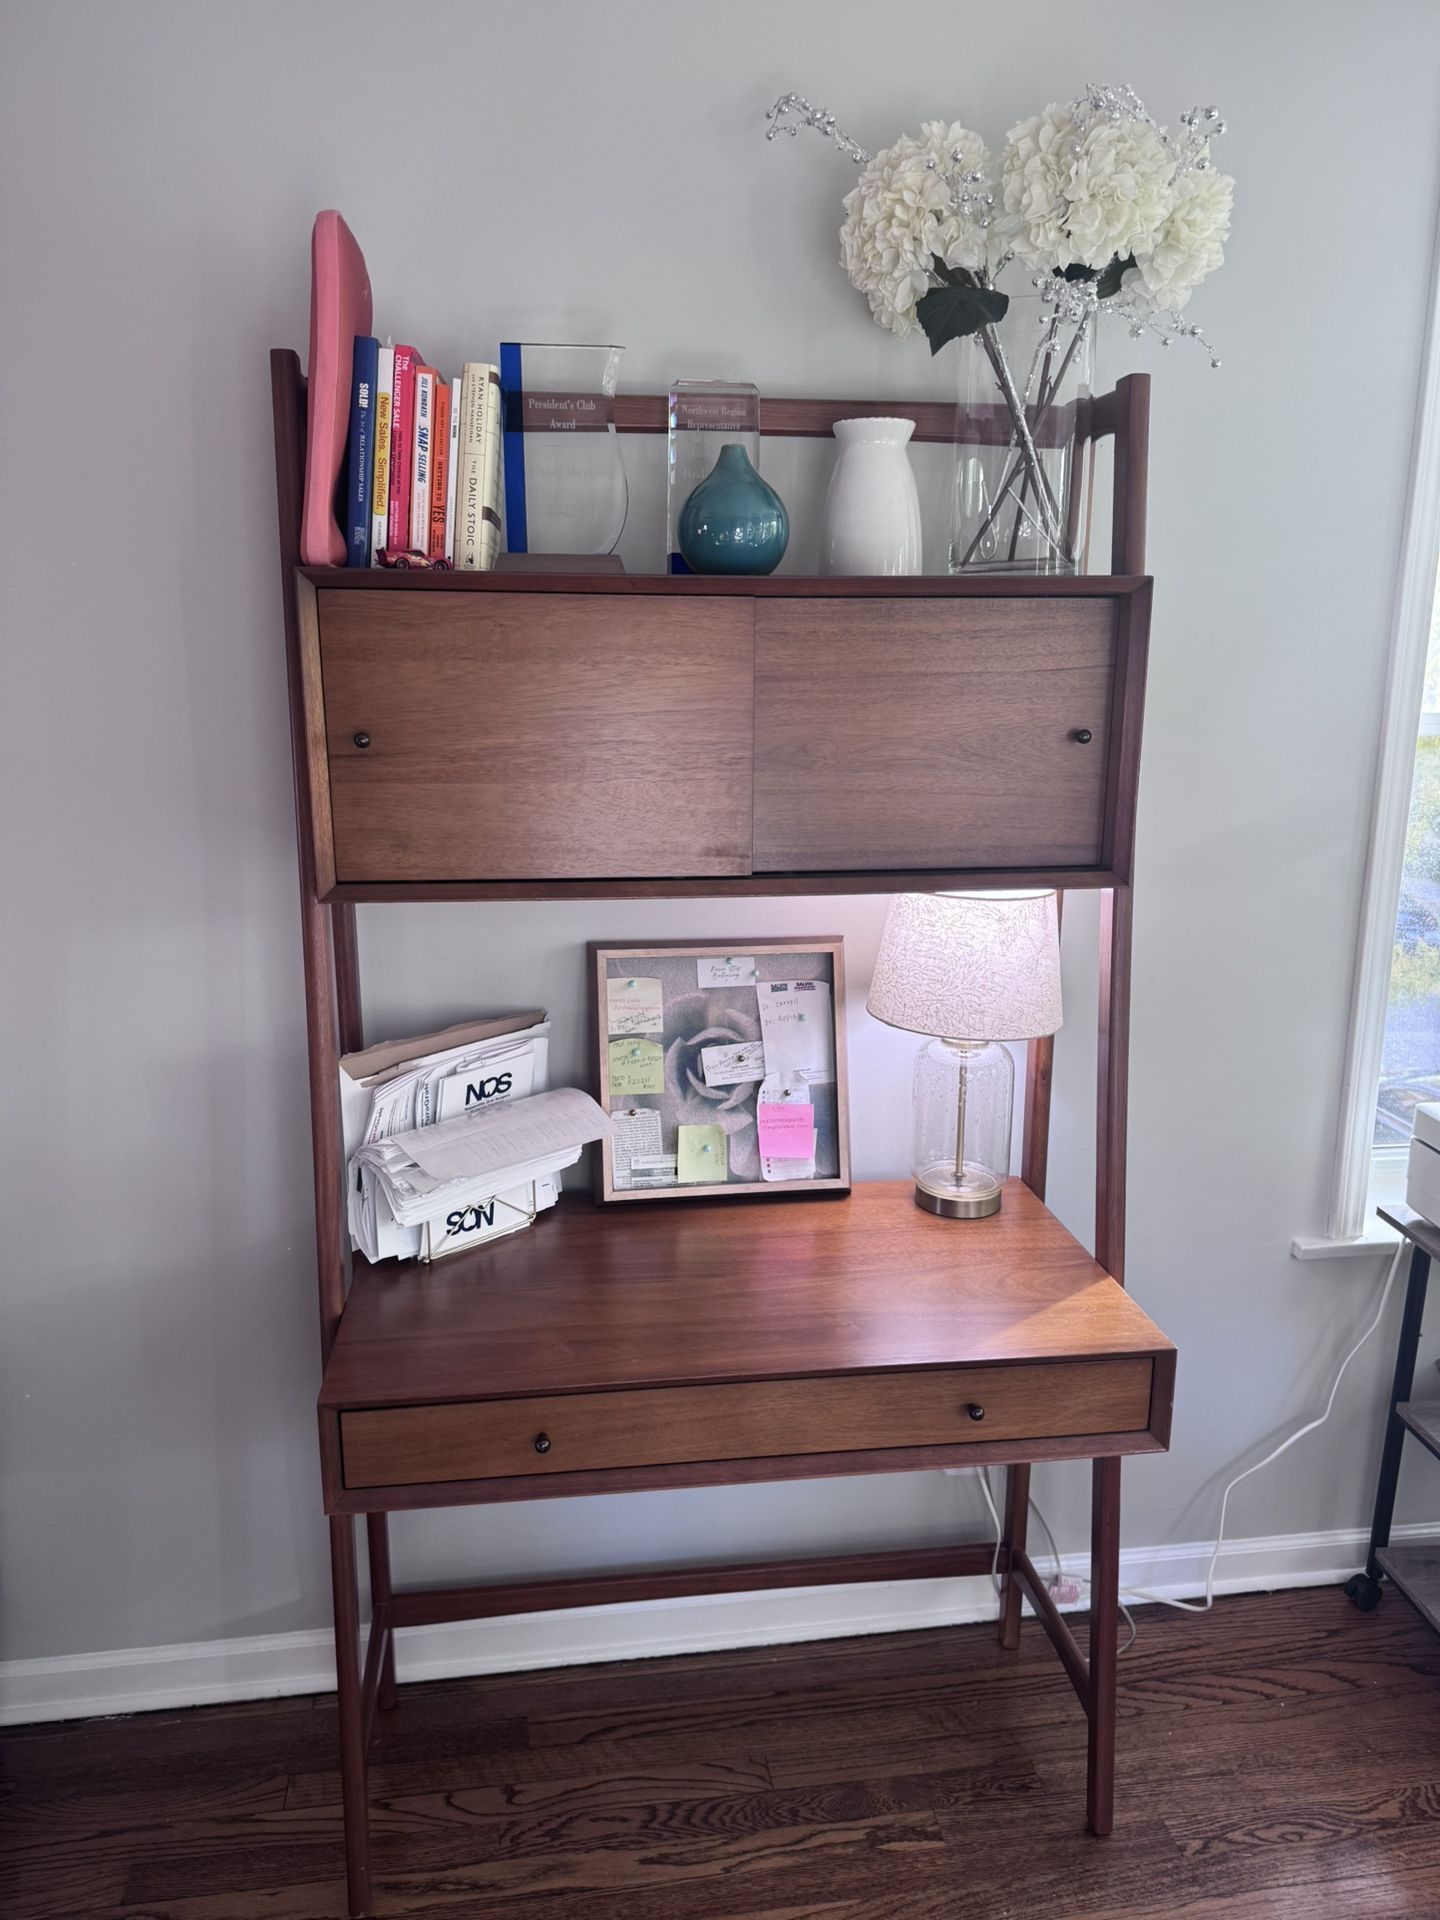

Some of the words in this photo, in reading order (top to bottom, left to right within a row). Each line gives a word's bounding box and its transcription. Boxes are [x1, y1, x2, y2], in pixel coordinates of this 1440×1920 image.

[402, 356, 411, 371] The
[394, 354, 403, 407] CHALLENGER
[421, 376, 429, 388] JILL
[477, 376, 485, 401] RYAN
[359, 383, 370, 408] SOLD!
[380, 396, 389, 419] New
[420, 389, 429, 418] KONRATH
[528, 398, 574, 411] President's
[576, 399, 596, 410] Club
[392, 408, 401, 429] SALE
[681, 403, 719, 416] Northwest
[720, 406, 747, 419] Region
[378, 421, 389, 453] Sales.
[475, 404, 484, 445] HOLIDAY
[550, 419, 577, 430] Award
[687, 418, 741, 432] Representative
[418, 425, 429, 453] SNAP
[417, 453, 427, 484] SELLING
[376, 457, 388, 510] Simplified.
[468, 477, 478, 510] DAILY
[432, 505, 445, 523] YES
[466, 513, 476, 546] STOIC
[465, 1072, 513, 1106] NOS
